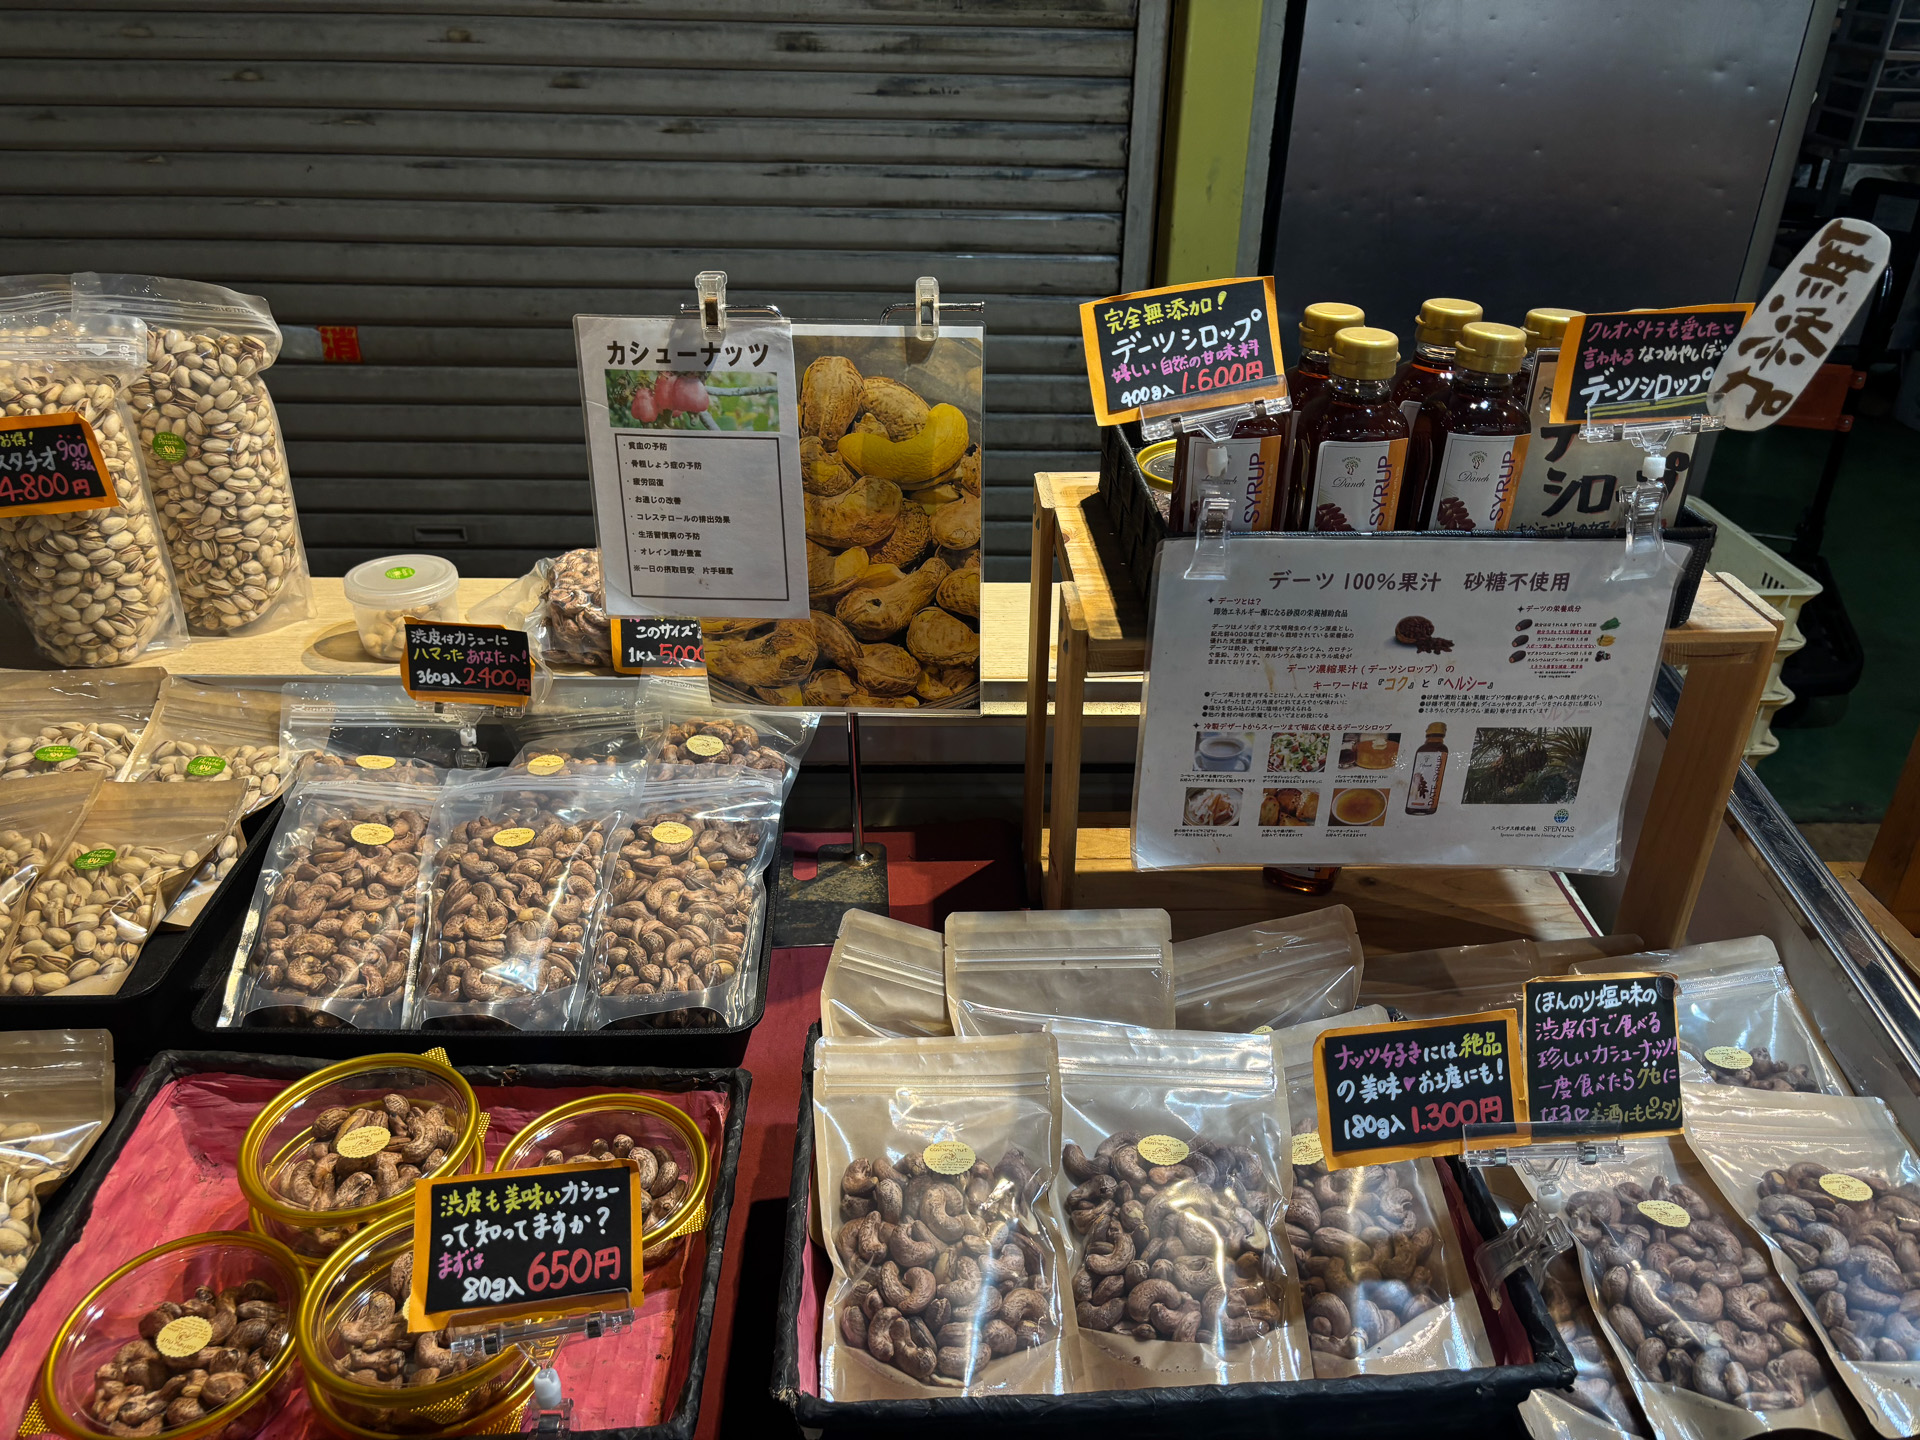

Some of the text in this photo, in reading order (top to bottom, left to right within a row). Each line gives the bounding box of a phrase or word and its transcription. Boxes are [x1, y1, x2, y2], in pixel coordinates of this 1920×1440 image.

[1588, 316, 1735, 342] クレオパトラも愛したと
[1713, 219, 1875, 420] 無添加
[1111, 308, 1262, 363] デーツシロップ
[606, 340, 769, 367] カシューナッツ
[1582, 347, 1634, 369] 言われる
[1580, 366, 1714, 407] デーツシロップ
[56, 440, 88, 460] 900
[628, 442, 668, 451] 貧血の予防
[72, 458, 96, 472] グラム
[631, 460, 702, 470] 骨粗しょう症の予防
[633, 478, 664, 487] 疲労回復
[1244, 453, 1265, 523] SYRUP
[1369, 456, 1392, 526] SYRUP
[1489, 451, 1515, 521] SYRUP
[635, 495, 681, 505] お通じの改善
[637, 513, 731, 524] コレステロールの排出効果
[638, 530, 700, 540] 生活習慣病の予防
[640, 548, 702, 558] オレイン酸が豊富
[702, 566, 734, 576] 片手程度
[1269, 569, 1570, 592] デーツ 100%果汁 砂糖不使用
[1526, 605, 1582, 613] デーツの栄養成分
[411, 630, 509, 647] 渋皮付カシューに
[636, 623, 701, 639] このサイズ
[1286, 664, 1358, 674] デーツ濃縮果汁
[463, 667, 531, 693] 2.400円
[1313, 680, 1368, 690] キーワードは
[1421, 679, 1430, 688] と
[1543, 825, 1575, 833] SPENTAS
[1334, 1031, 1502, 1071] ナッツ好きには絶品
[1411, 1096, 1503, 1133] 1.300円
[440, 1180, 620, 1217] 渋皮も美味いカシュー
[438, 1247, 484, 1280] まずは
[527, 1246, 621, 1292] 650円
